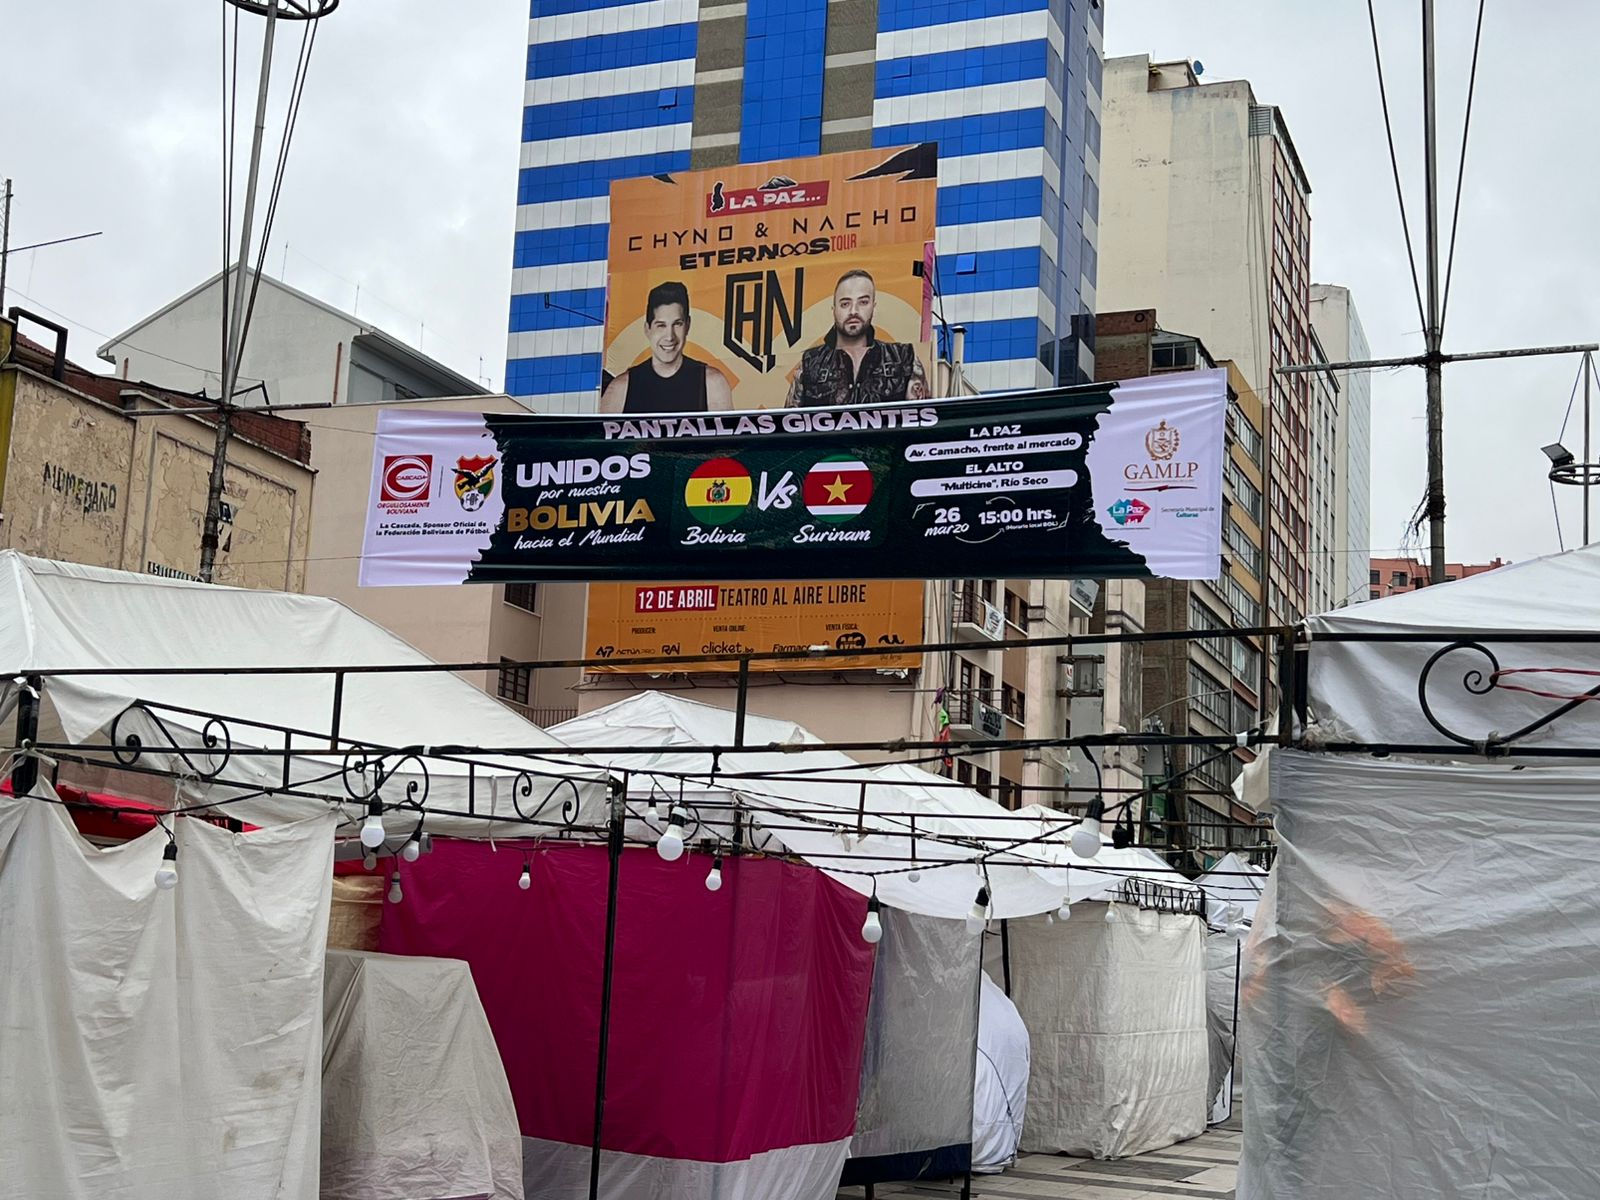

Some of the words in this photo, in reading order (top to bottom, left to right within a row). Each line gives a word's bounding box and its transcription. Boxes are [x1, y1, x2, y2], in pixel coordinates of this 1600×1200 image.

[729, 195, 757, 209] LA
[764, 190, 821, 205] PAZ...
[629, 226, 733, 251] CHYNO
[755, 222, 769, 238] &
[793, 206, 917, 234] NACHO
[831, 233, 857, 252] TOUR
[603, 414, 777, 440] PANTALLAS
[782, 408, 939, 433] GIGANTES
[970, 427, 990, 438] LA
[993, 425, 1021, 437] PAZ
[909, 449, 926, 458] Av.
[929, 446, 981, 457] Camacho,
[983, 442, 1014, 453] frente
[1017, 441, 1027, 450] al
[1029, 438, 1076, 449] mercado
[516, 453, 652, 488] UNIDOS
[965, 464, 983, 475] EL
[985, 461, 1025, 473] ALTO
[1124, 462, 1199, 480] GAMLP
[757, 470, 798, 511] Vs
[1001, 477, 1020, 487] Río
[1022, 476, 1048, 486] Seco
[537, 489, 564, 506] por
[568, 482, 621, 498] nuestra
[377, 501, 430, 509] ORGULLOSAMENTE
[1113, 506, 1125, 514] La
[1126, 505, 1144, 514] Paz
[423, 521, 451, 529] Sponsor
[507, 499, 656, 533] BOLIVIA
[934, 507, 961, 525] 26
[979, 508, 1023, 526] 15:00
[1027, 508, 1056, 521] hrs.
[514, 534, 553, 551] hacia
[558, 532, 575, 547] el
[579, 527, 646, 547] Mundial
[681, 526, 746, 546] Bolivia
[793, 525, 871, 544] Surinam
[924, 522, 970, 537] marzo
[639, 592, 654, 609] 12
[658, 590, 674, 609] DE
[678, 589, 715, 608] ABRIL
[720, 588, 768, 607] TEATRO
[772, 587, 788, 605] AL
[793, 585, 823, 604] AIRE
[828, 584, 866, 603] LIBRE
[825, 624, 841, 632] VENTA
